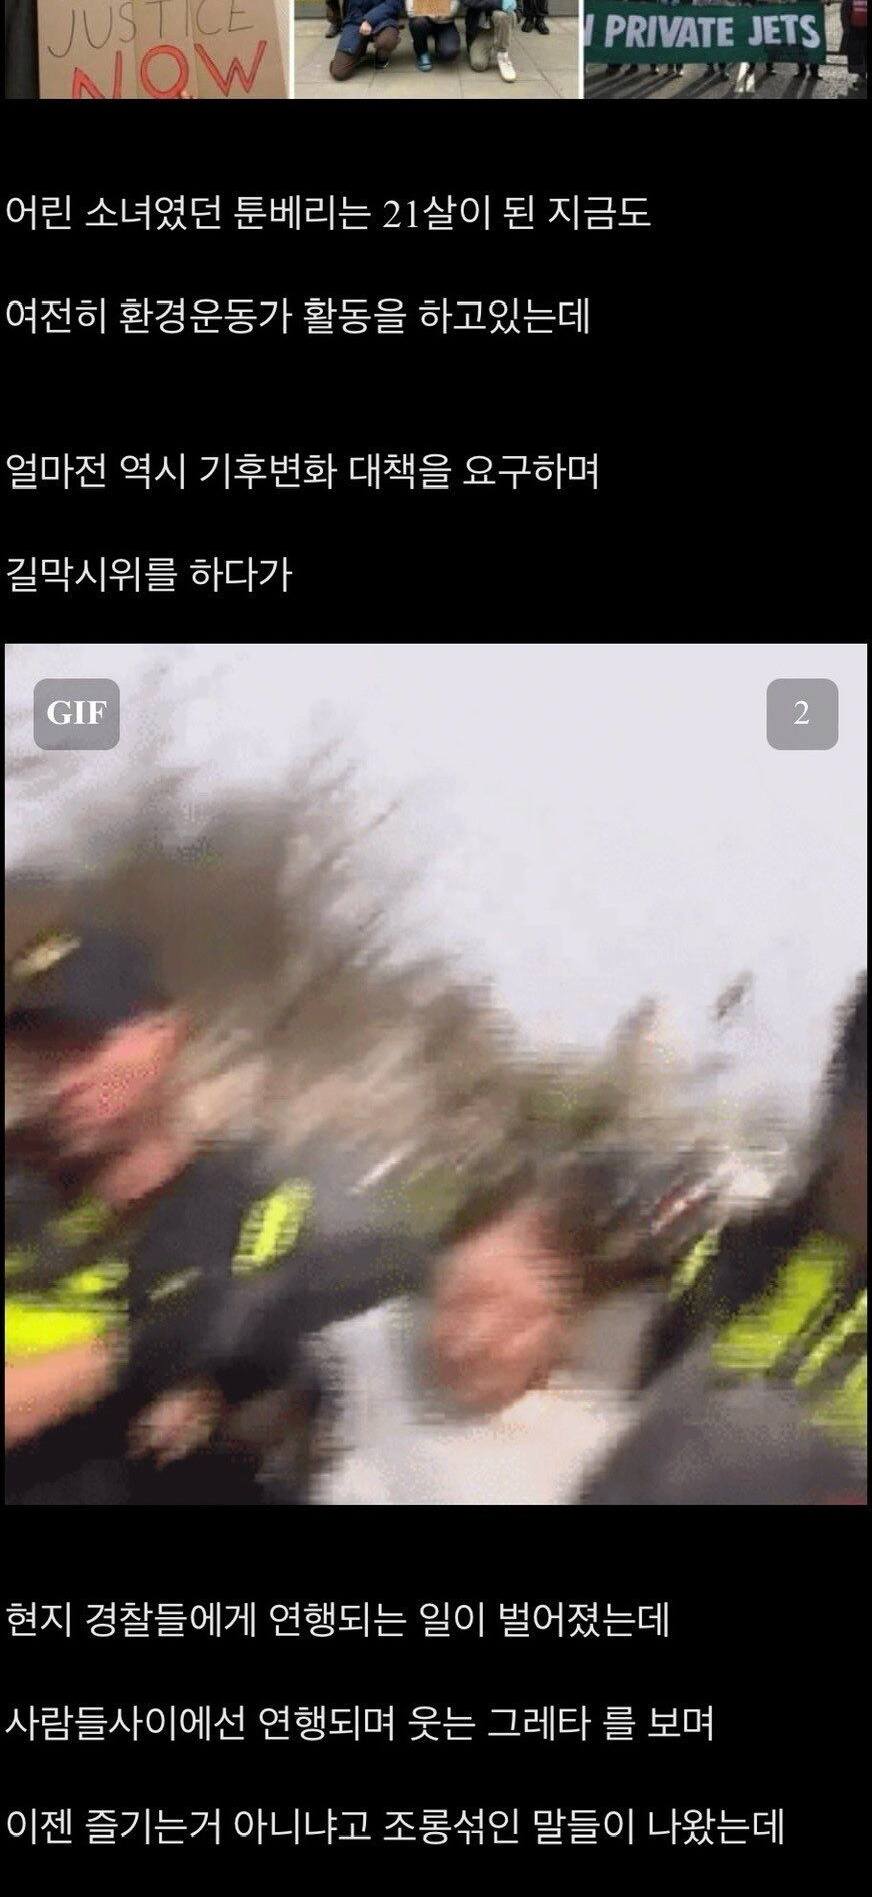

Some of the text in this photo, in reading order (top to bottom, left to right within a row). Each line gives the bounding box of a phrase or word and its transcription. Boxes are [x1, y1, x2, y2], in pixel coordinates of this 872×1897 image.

[604, 13, 734, 48] PRIVATE
[748, 13, 821, 49] JETS
[72, 40, 268, 99] NOW
[7, 195, 651, 230] 어린 소녀였던 툰베리는 21살이 된 지금도
[6, 298, 589, 334] 여전히 환경운동가 활동을 하고있는데
[7, 453, 599, 489] 얼마전 역시 기후변화 대책을 요구하며
[6, 557, 292, 592] 길막시위를 하다가
[6, 1601, 669, 1638] 현지 경찰들에게 연행되는 일이 벌어졌는데
[5, 1705, 714, 1741] 사람들사이에선 연행되며 웃는 그레타 를 보며
[7, 1808, 785, 1845] 이젠 즐기는거 아니냐고 조롱섞인 말들이 나왔는데
